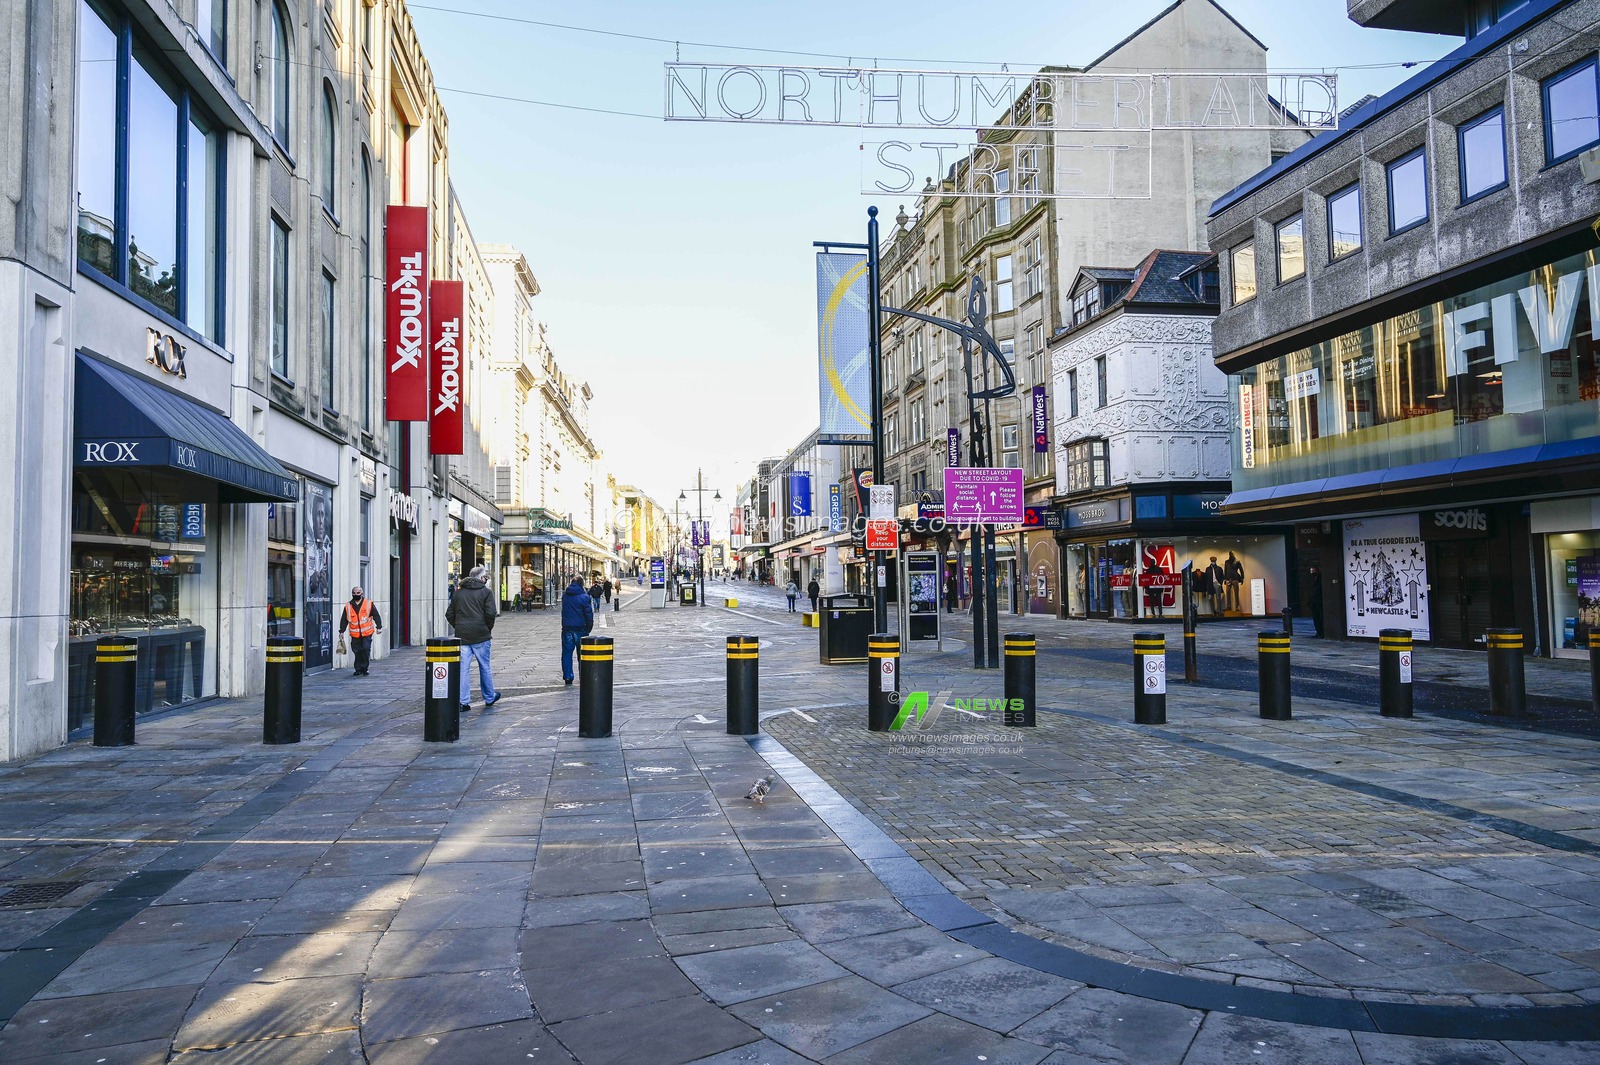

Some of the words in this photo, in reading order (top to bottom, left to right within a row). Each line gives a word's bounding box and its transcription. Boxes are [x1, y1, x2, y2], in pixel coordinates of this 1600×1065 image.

[667, 67, 1335, 129] NORTHUMBERLAND
[875, 140, 1130, 196] STREET
[146, 327, 187, 379] ROX
[1034, 394, 1045, 433] NatWest
[84, 441, 139, 462] ROX
[177, 445, 196, 468] ROX
[949, 434, 958, 466] NatWest
[831, 495, 840, 530] GREGGS
[1434, 509, 1487, 531] scotts
[1363, 538, 1378, 546] TRUE
[1378, 537, 1404, 545] GEORDIE
[1370, 607, 1404, 615] NEWCASTLE
